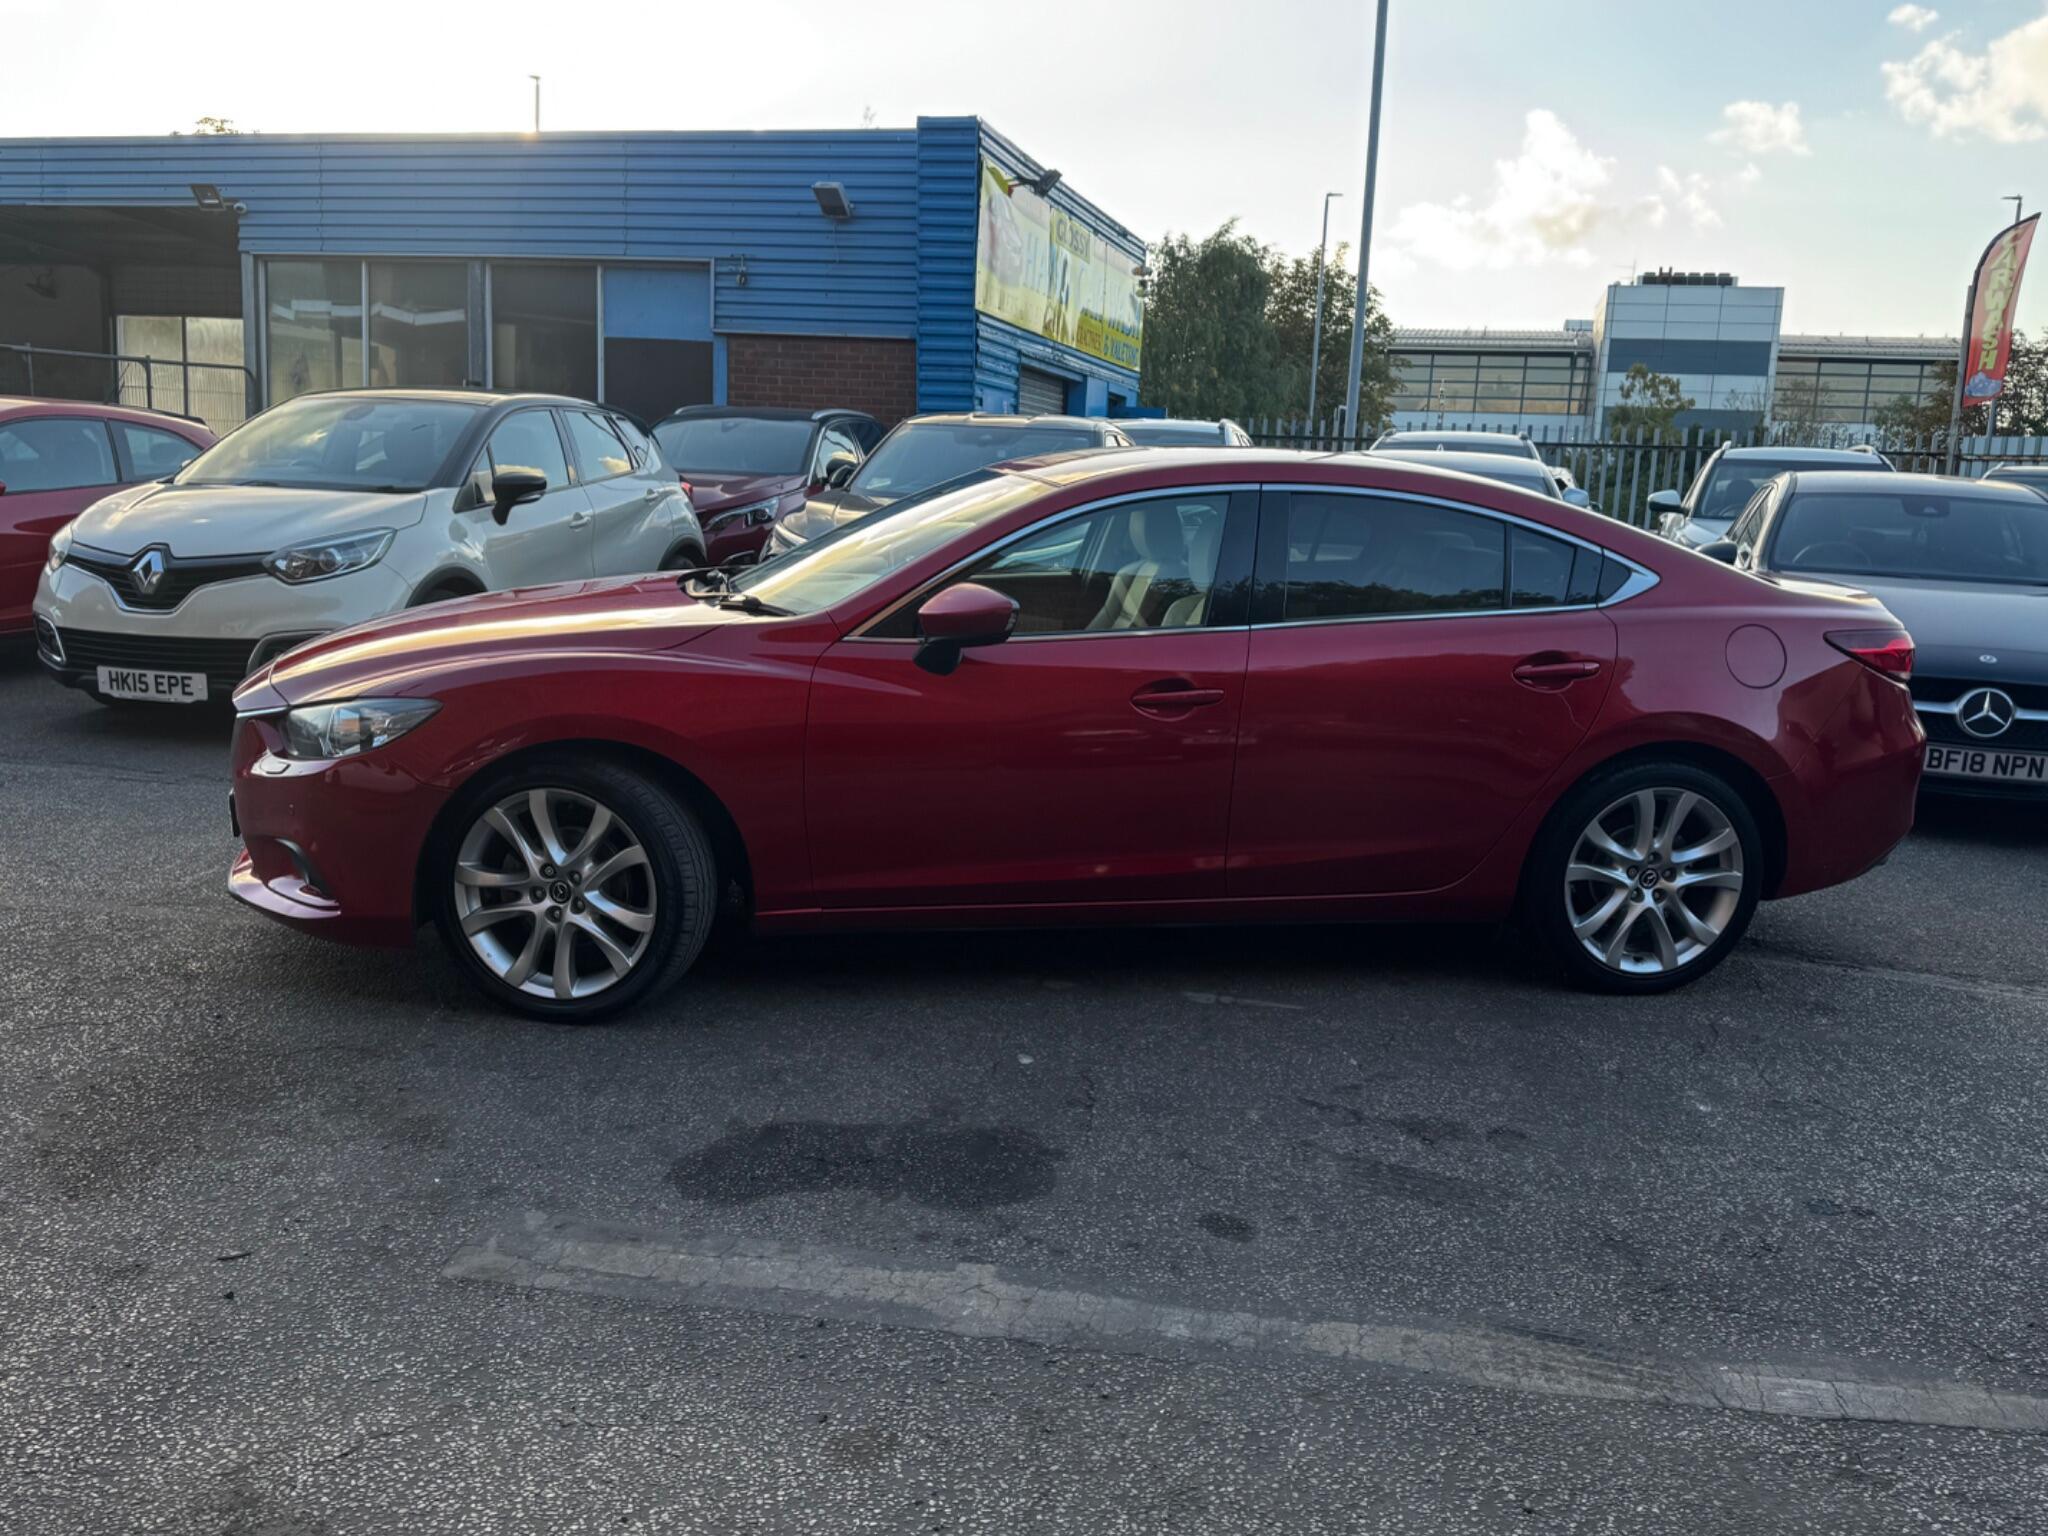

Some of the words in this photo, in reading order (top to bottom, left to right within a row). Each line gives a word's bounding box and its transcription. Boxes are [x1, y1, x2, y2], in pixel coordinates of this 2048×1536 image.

[1056, 218, 1089, 258] GLOSSY
[108, 670, 149, 693] HK15
[154, 674, 194, 696] EPE
[1926, 748, 1986, 773] BF18
[1992, 754, 2045, 778] NPN
